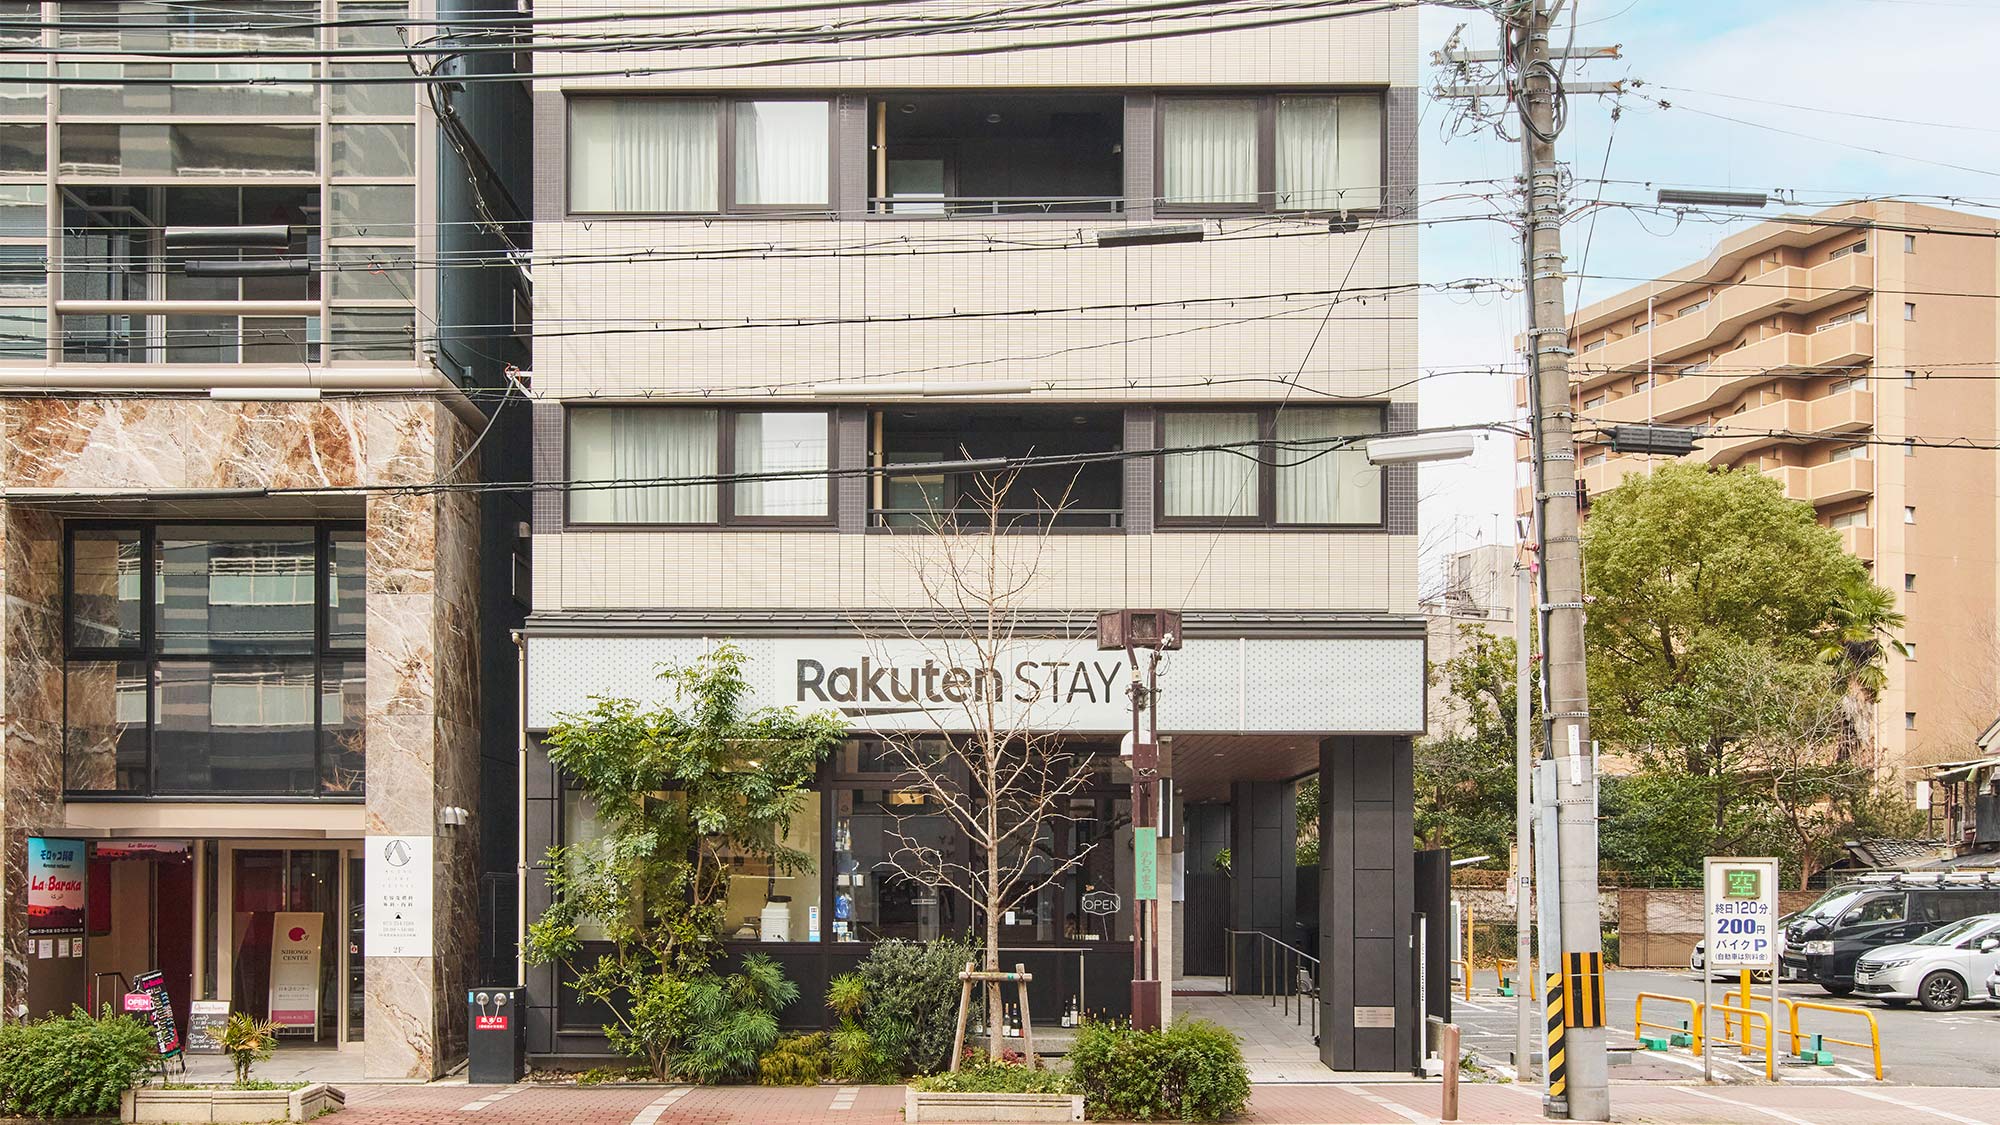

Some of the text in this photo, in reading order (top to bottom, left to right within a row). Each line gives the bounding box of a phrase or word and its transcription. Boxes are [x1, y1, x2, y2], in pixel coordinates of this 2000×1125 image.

[796, 656, 1122, 704] Rakuten STAY
[31, 875, 82, 892] La Baraka
[1729, 871, 1756, 896] 空
[1084, 899, 1119, 910] OPEN
[1715, 901, 1768, 915] 終日120分
[1717, 918, 1766, 935] 200円
[127, 998, 149, 1006] OPEN
